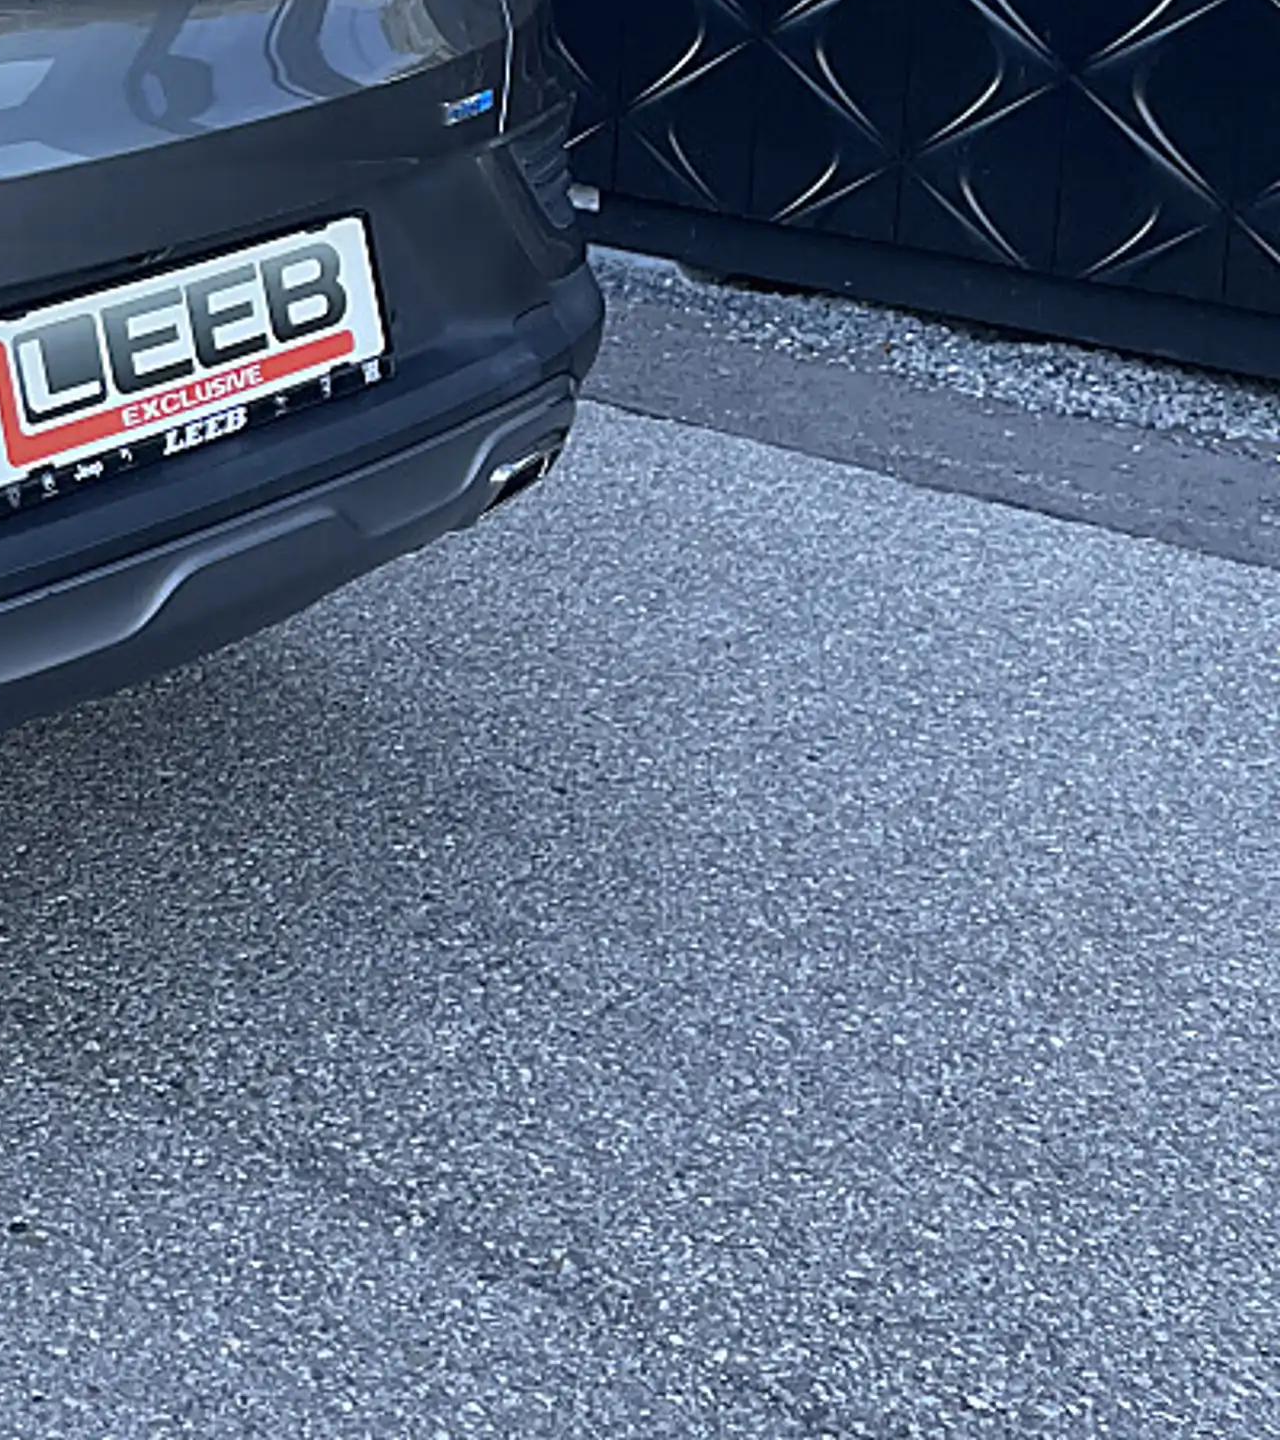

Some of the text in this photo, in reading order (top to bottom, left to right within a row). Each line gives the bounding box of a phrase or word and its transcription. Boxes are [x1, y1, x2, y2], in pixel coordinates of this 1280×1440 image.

[12, 242, 348, 425] LEEB
[121, 364, 264, 427] EXCLUSIVE
[162, 406, 249, 456] LEEB
